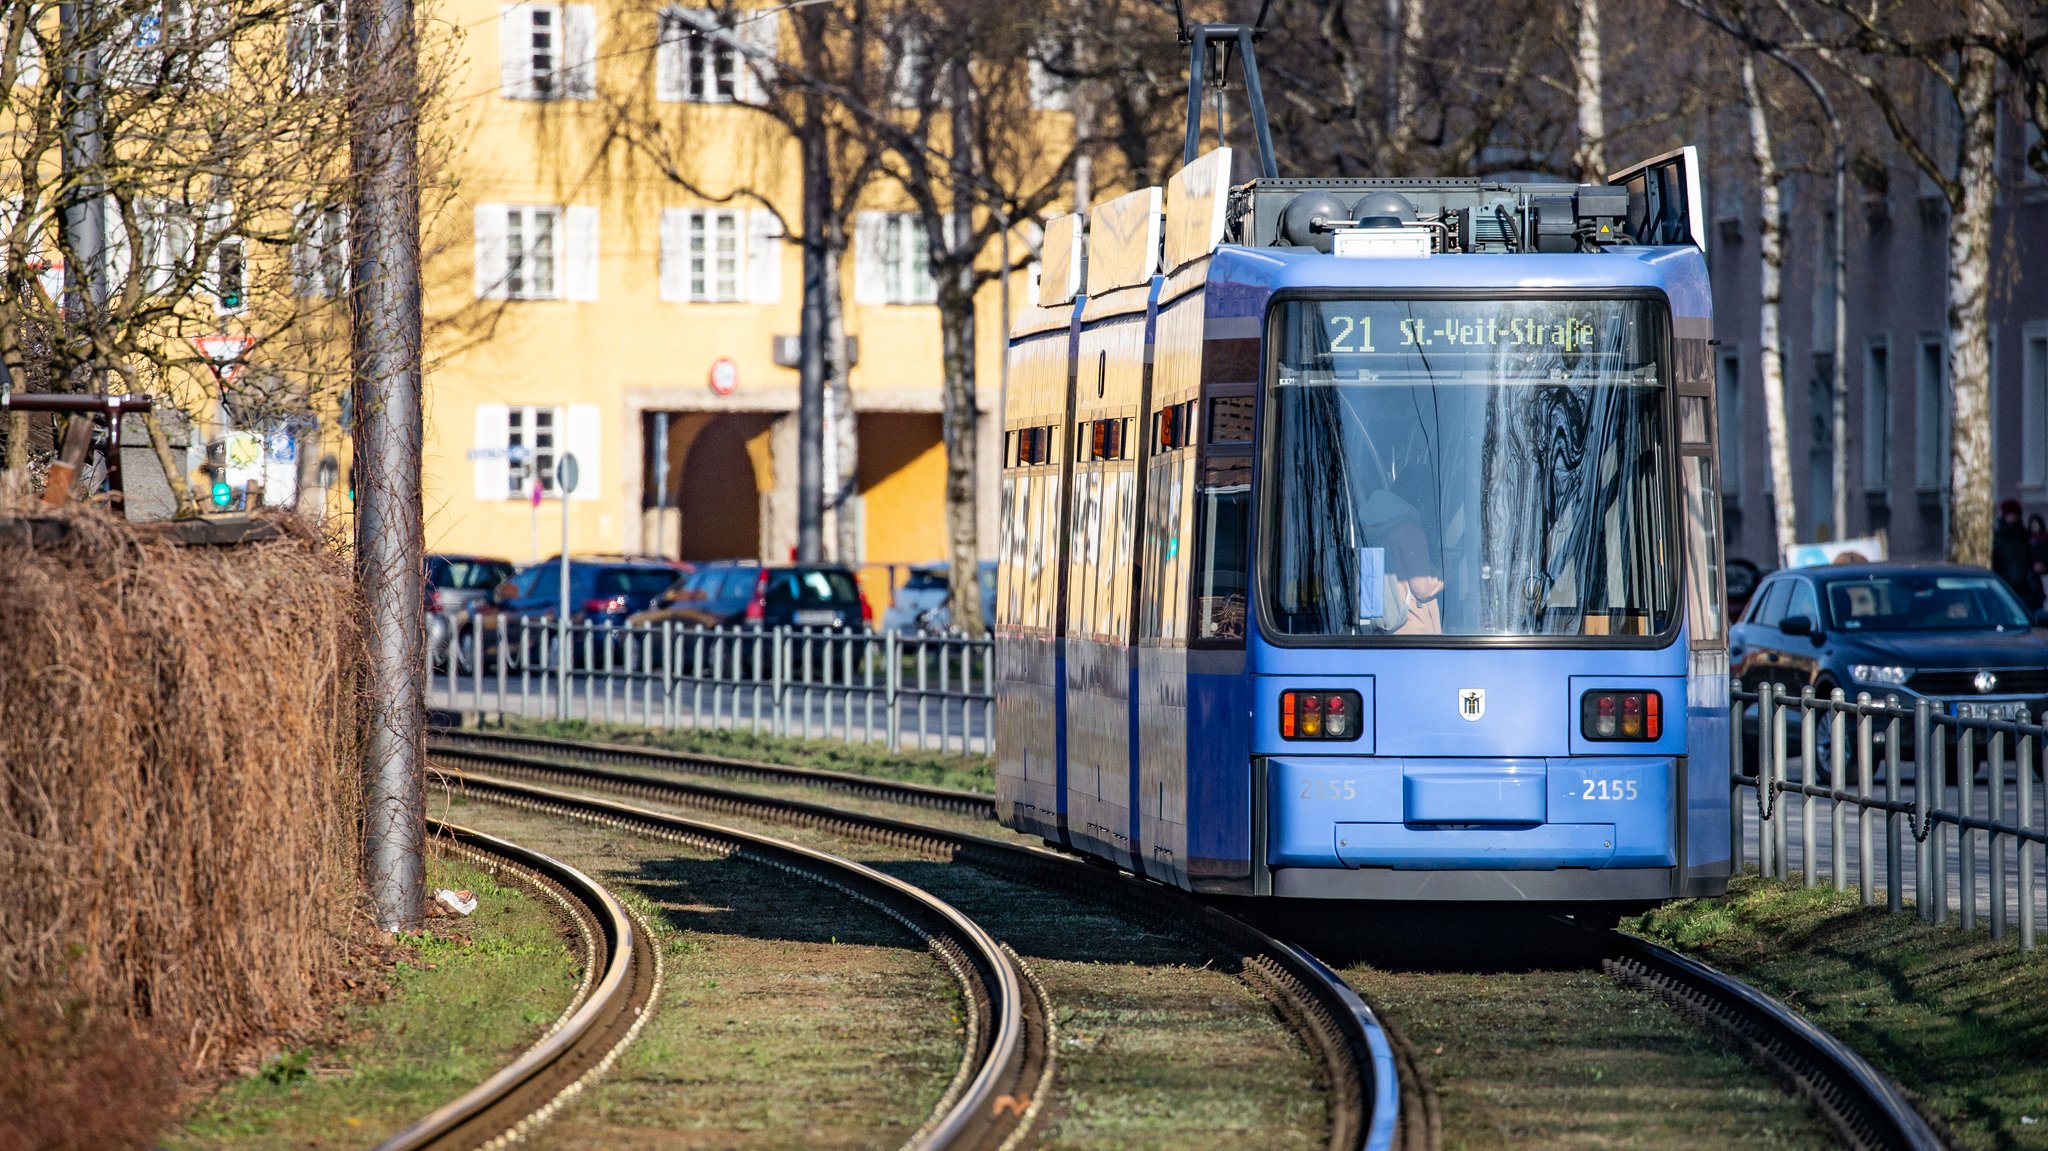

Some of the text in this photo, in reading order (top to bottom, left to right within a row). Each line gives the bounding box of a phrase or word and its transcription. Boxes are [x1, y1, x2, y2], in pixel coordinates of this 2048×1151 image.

[1330, 316, 1594, 352] 21 St.-Veit-Straße
[1300, 779, 1357, 800] 2155
[1582, 779, 1638, 801] 2155
